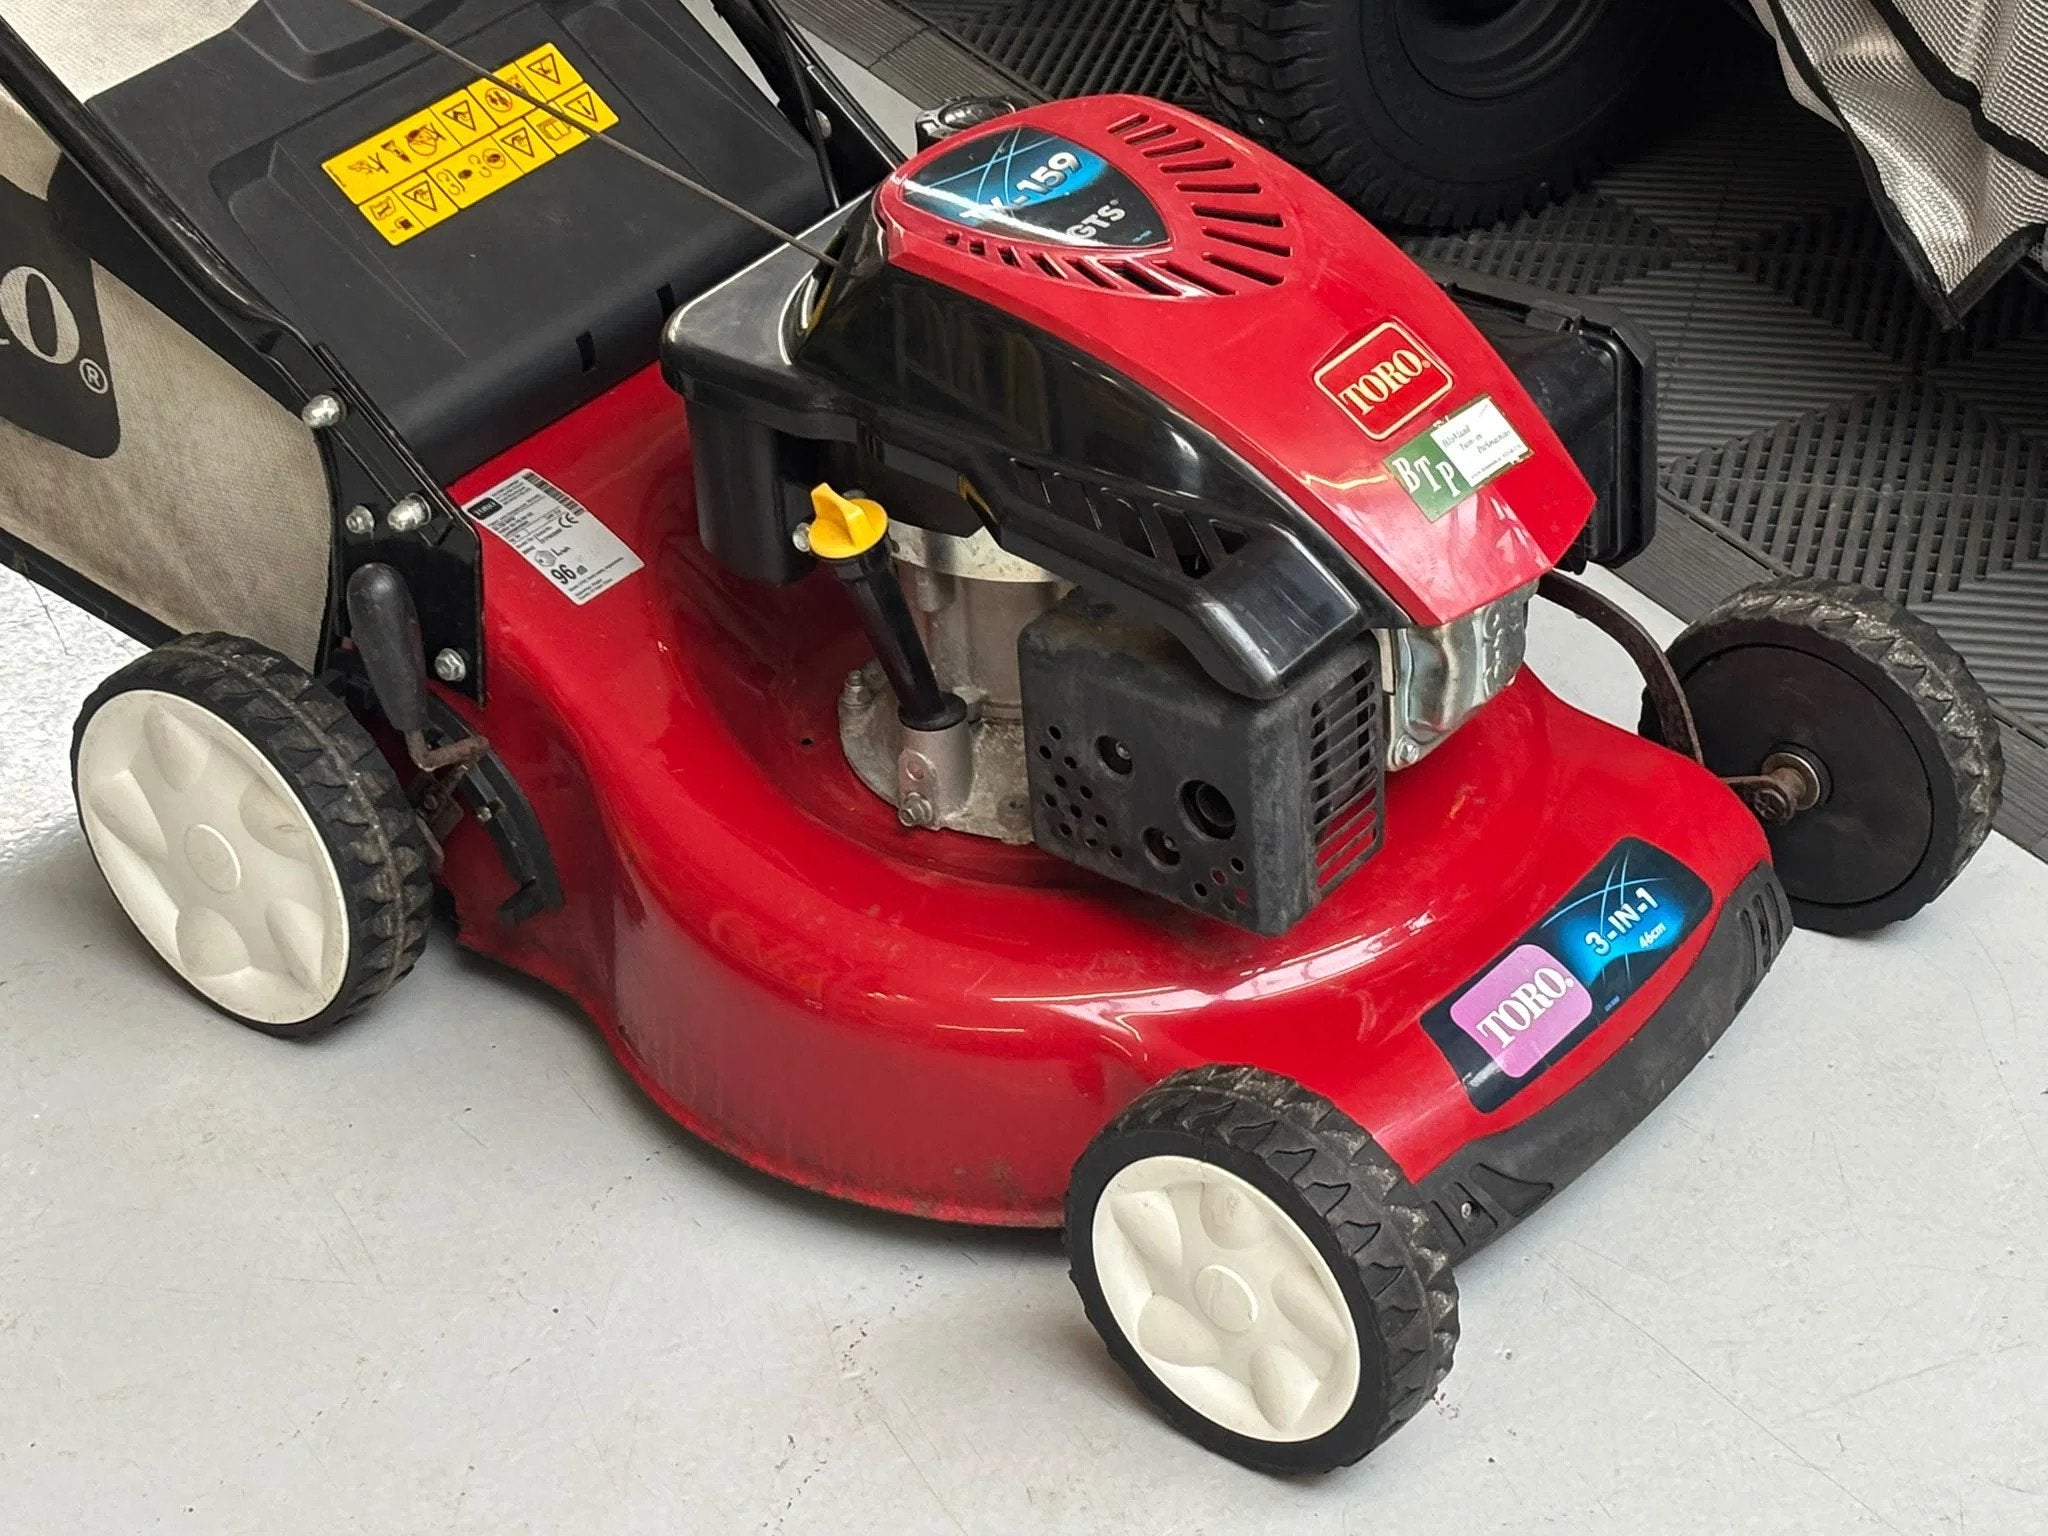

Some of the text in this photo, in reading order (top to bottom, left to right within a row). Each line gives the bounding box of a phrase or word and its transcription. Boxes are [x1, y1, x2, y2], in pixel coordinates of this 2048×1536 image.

[1066, 203, 1126, 240] GTS
[0, 266, 80, 365] O
[1338, 349, 1425, 416] TORO
[1391, 455, 1462, 498] BTP
[550, 564, 577, 585] 96
[1585, 886, 1659, 955] 3-IN-1
[1638, 922, 1667, 949] 46cm
[1475, 967, 1568, 1049] TORO
